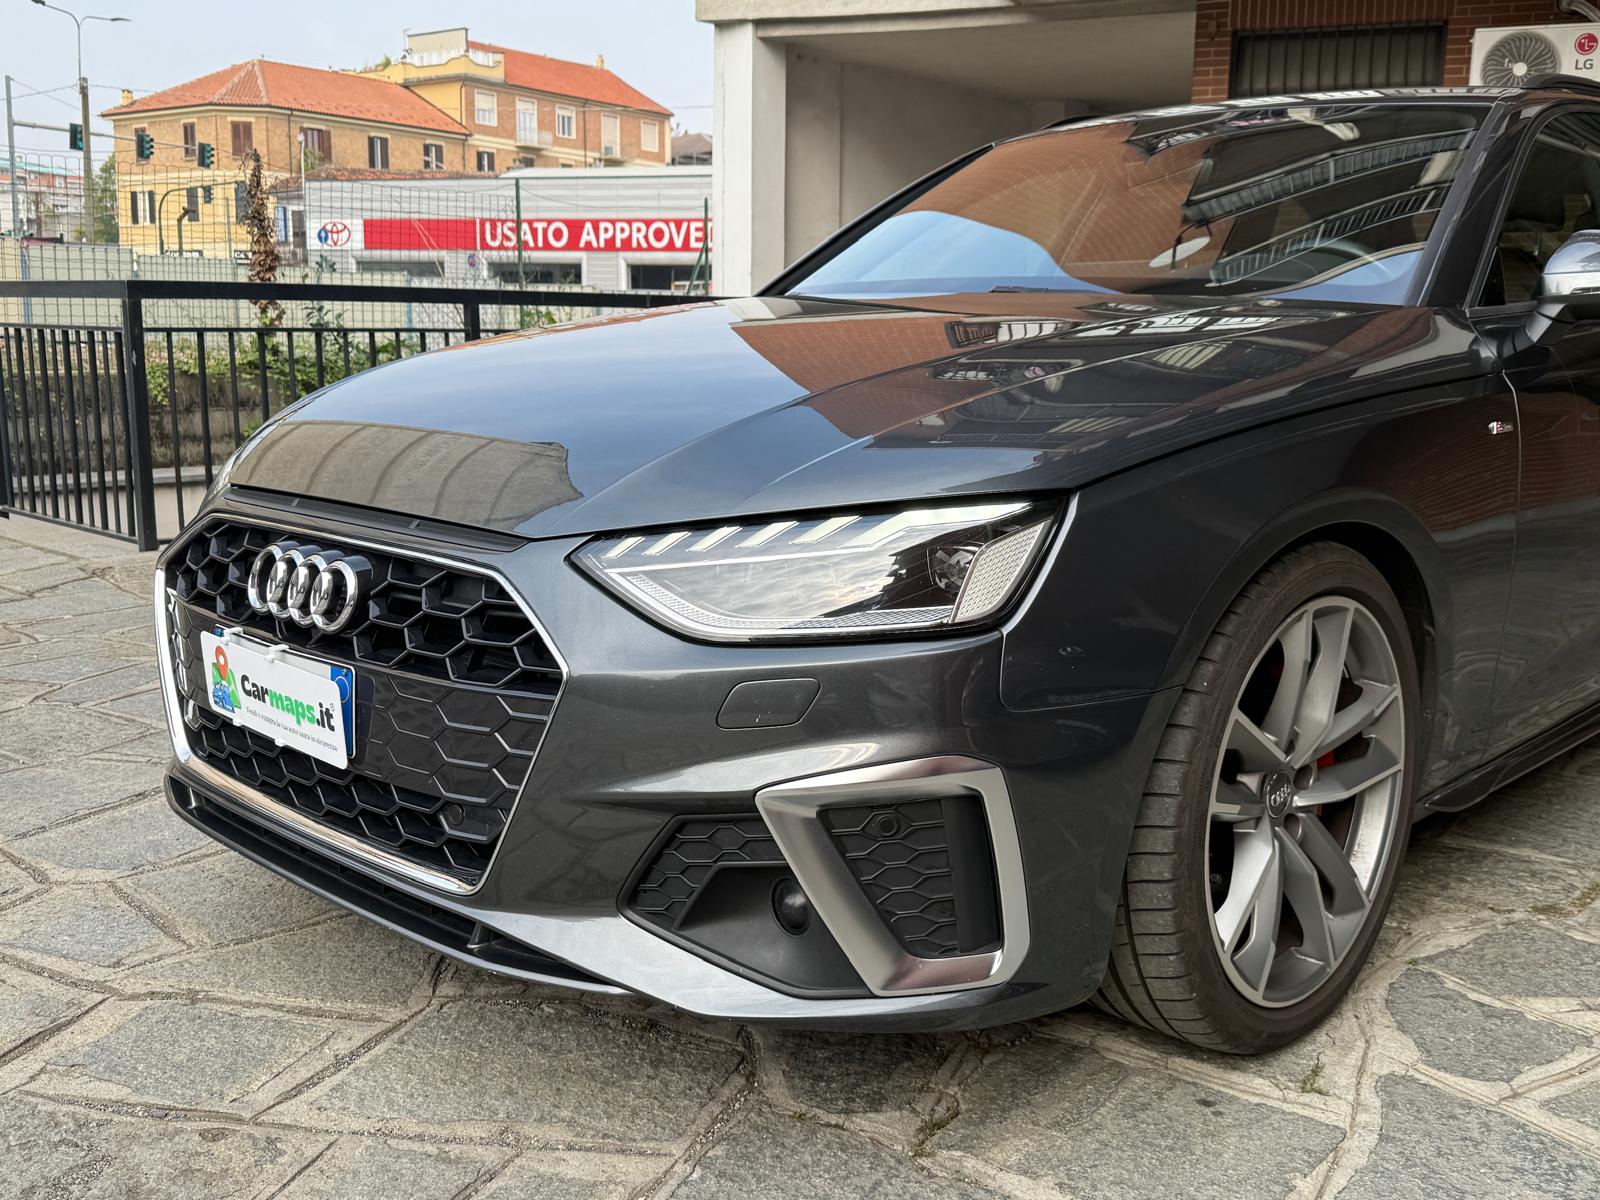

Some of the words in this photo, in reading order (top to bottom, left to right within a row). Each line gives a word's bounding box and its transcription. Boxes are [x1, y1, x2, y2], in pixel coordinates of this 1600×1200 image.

[1575, 59, 1594, 71] LG
[485, 221, 569, 249] USATO
[579, 221, 713, 249] APPROVE
